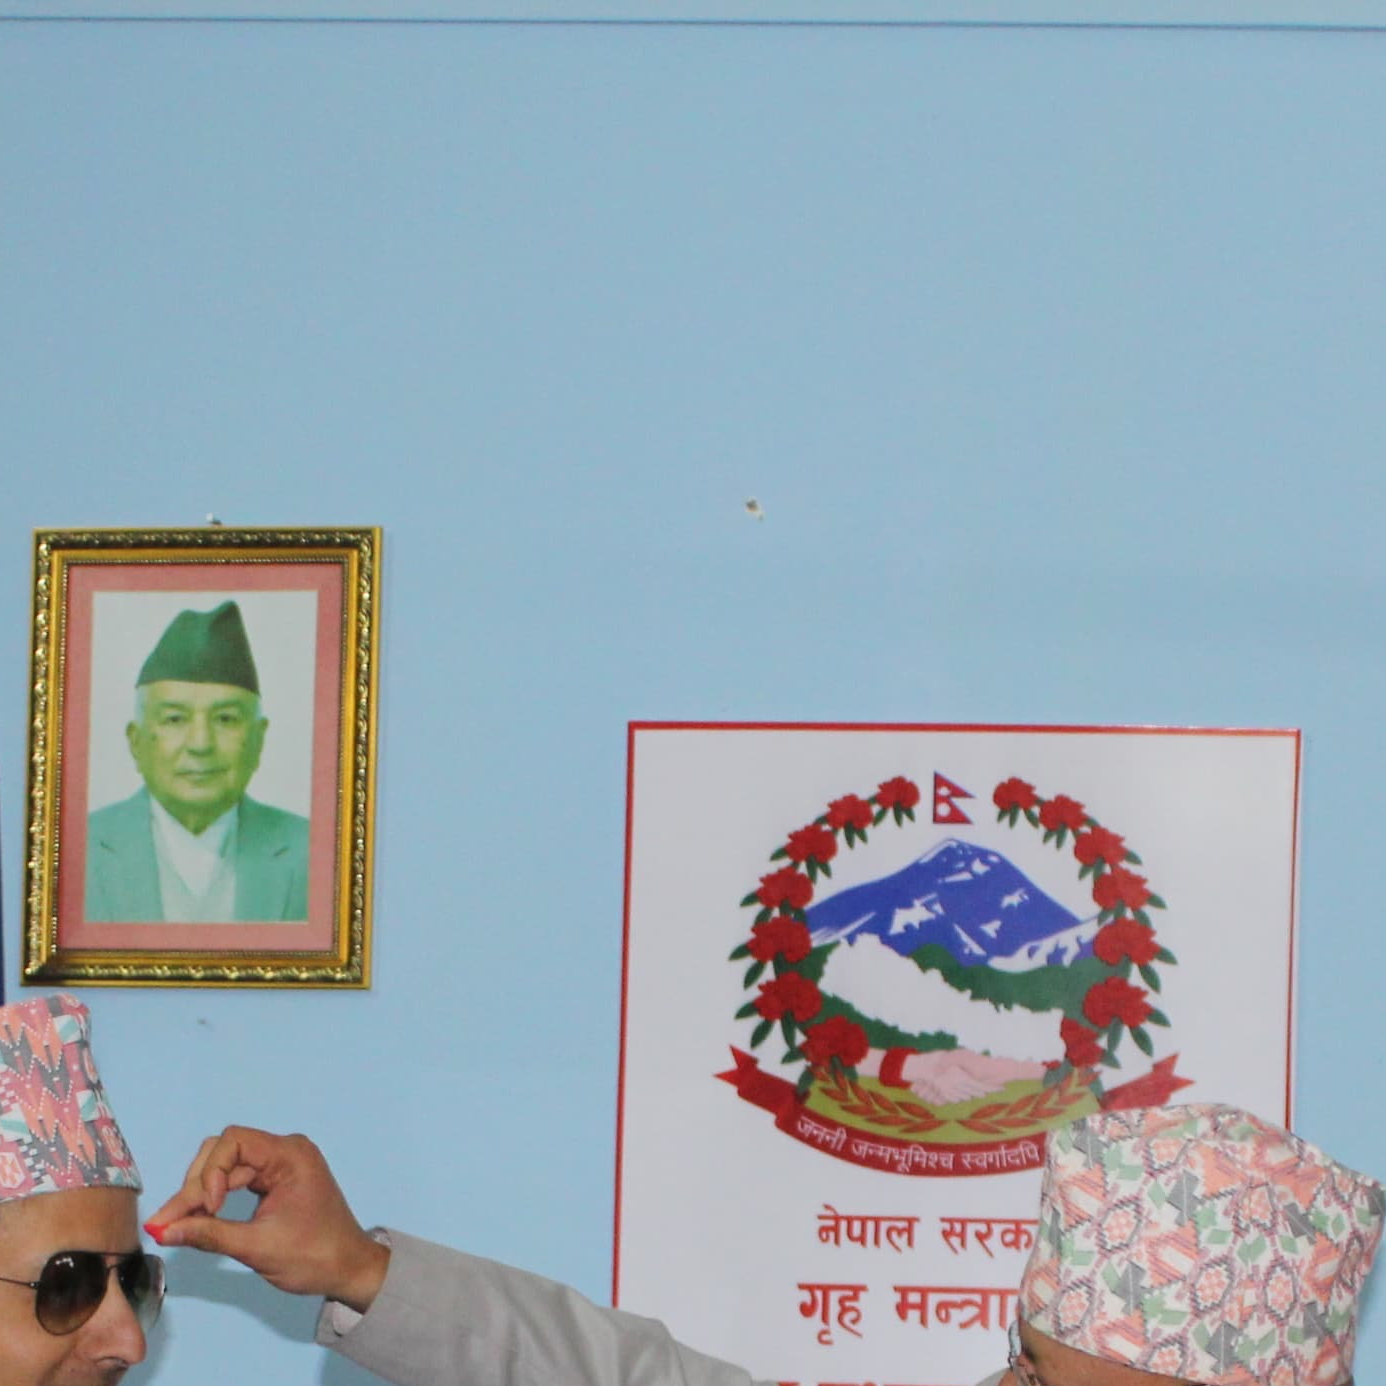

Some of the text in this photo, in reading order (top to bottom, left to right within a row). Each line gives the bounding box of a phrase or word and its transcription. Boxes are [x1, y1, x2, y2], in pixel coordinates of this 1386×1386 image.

[796, 1115, 847, 1152] जननी
[851, 1137, 954, 1174] जन्मभूमिश्च
[817, 1203, 1041, 1258] नेपाल सरक
[797, 1282, 1021, 1346] गृह मन्त्रा
